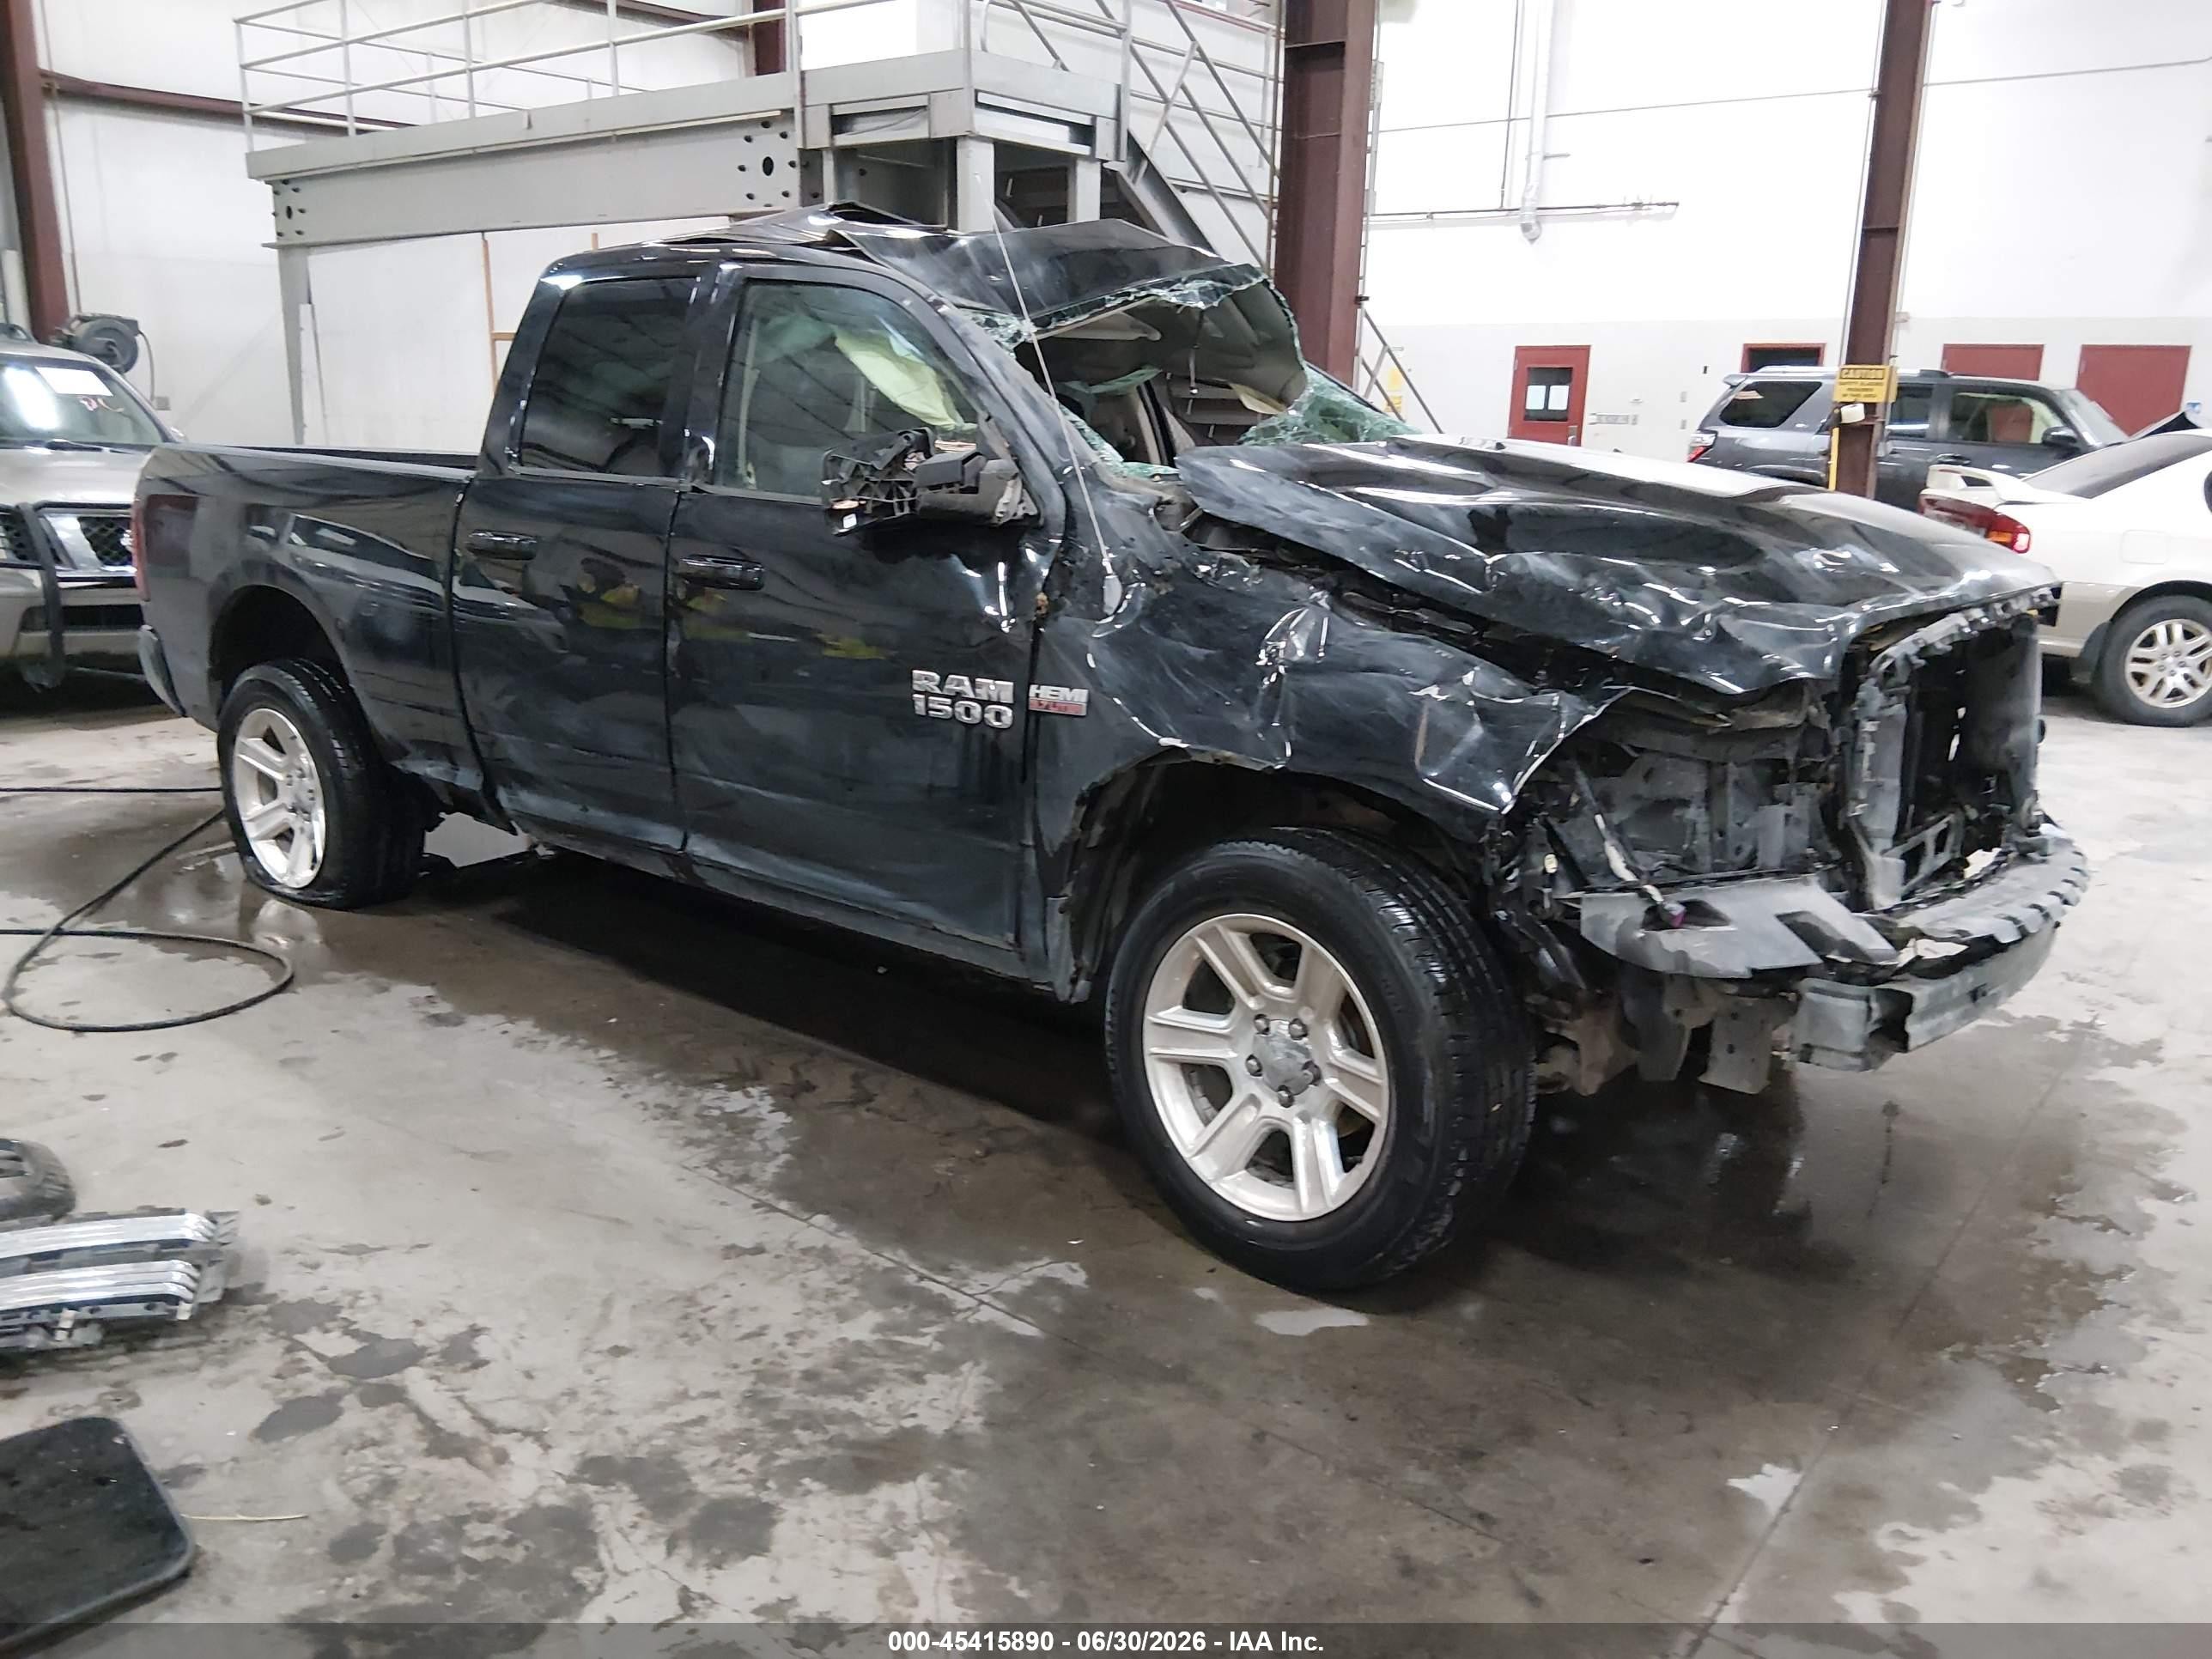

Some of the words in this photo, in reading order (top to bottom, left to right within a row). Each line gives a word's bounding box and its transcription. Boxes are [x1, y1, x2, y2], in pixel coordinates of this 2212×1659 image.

[912, 670, 1014, 704] RAM
[1029, 684, 1089, 702] HEMI
[912, 694, 1014, 729] 1500
